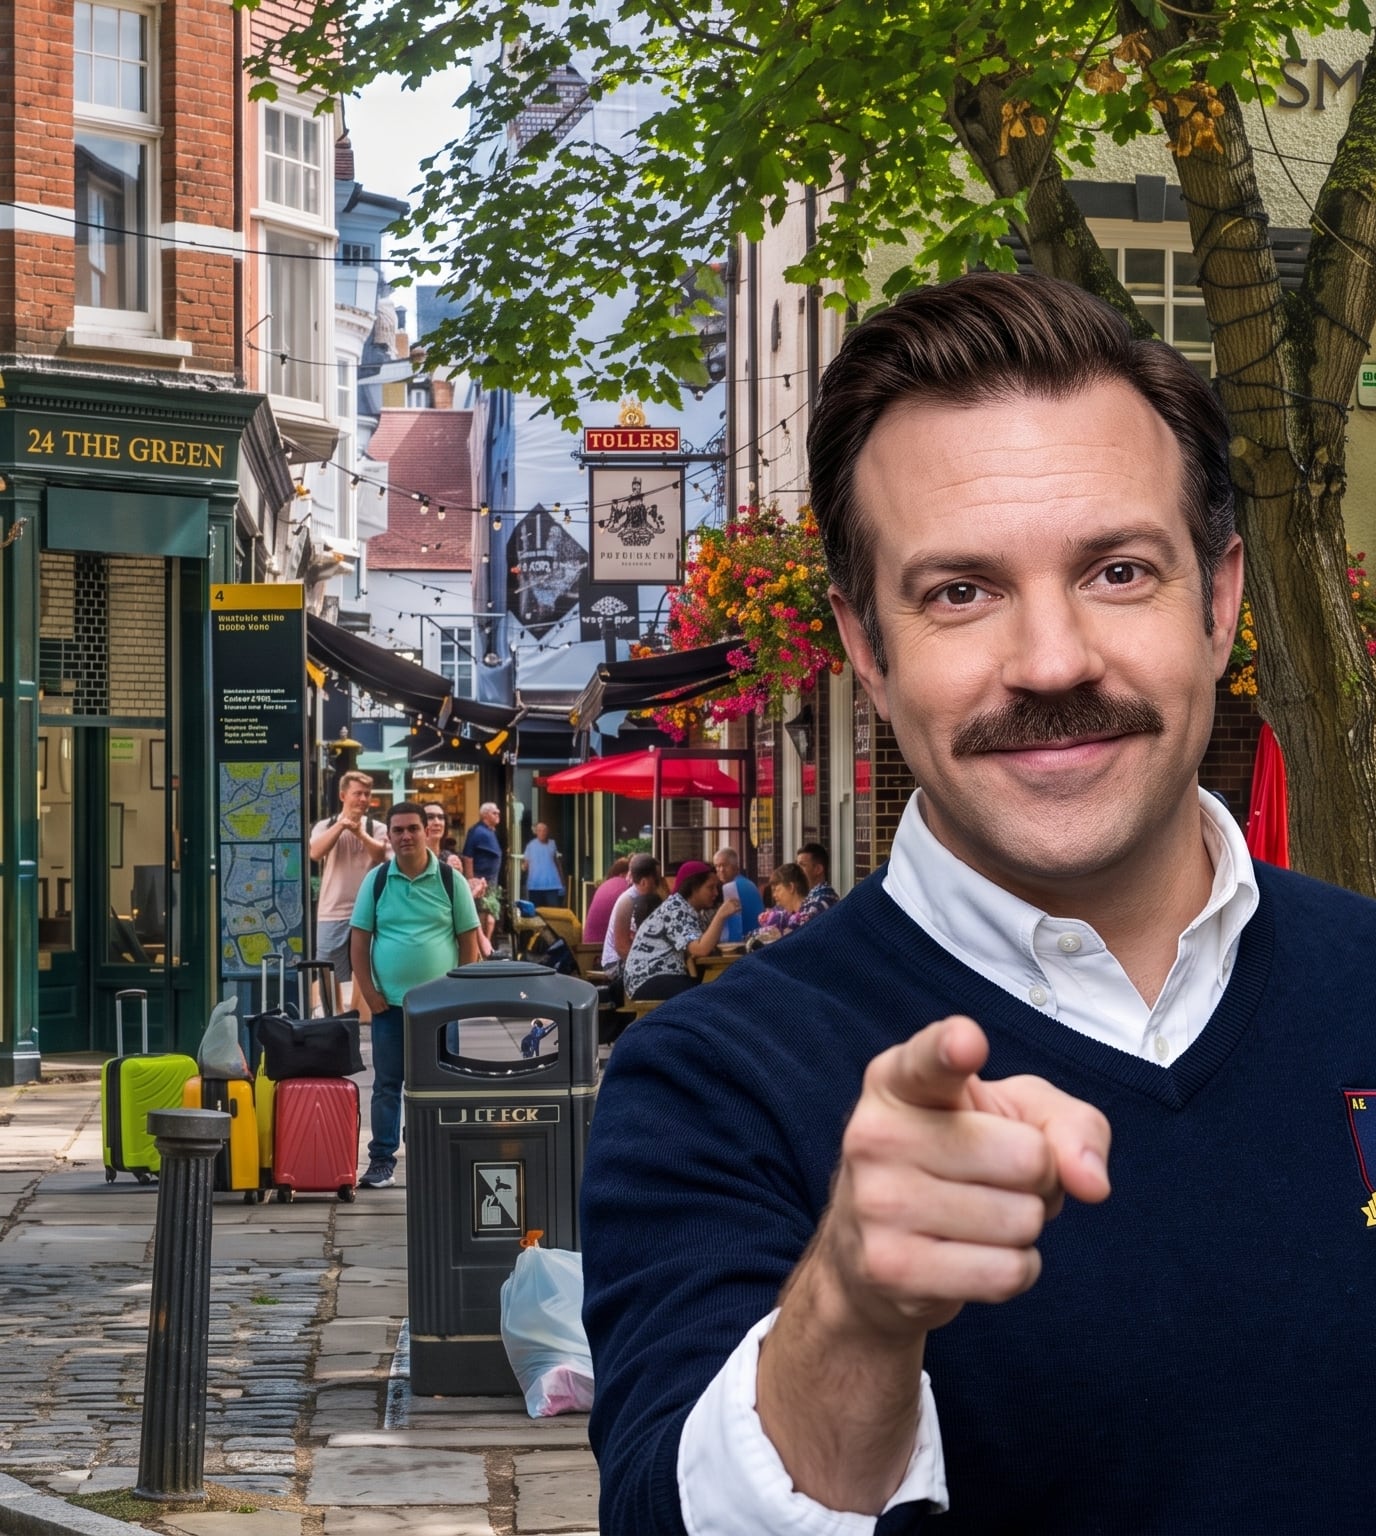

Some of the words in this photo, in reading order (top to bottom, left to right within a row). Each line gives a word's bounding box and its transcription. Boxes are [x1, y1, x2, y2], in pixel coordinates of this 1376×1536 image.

[27, 428, 55, 454] 24
[62, 430, 120, 460] THE
[129, 437, 224, 468] GREEN
[590, 433, 675, 448] TOLLERS
[215, 590, 224, 602] 4
